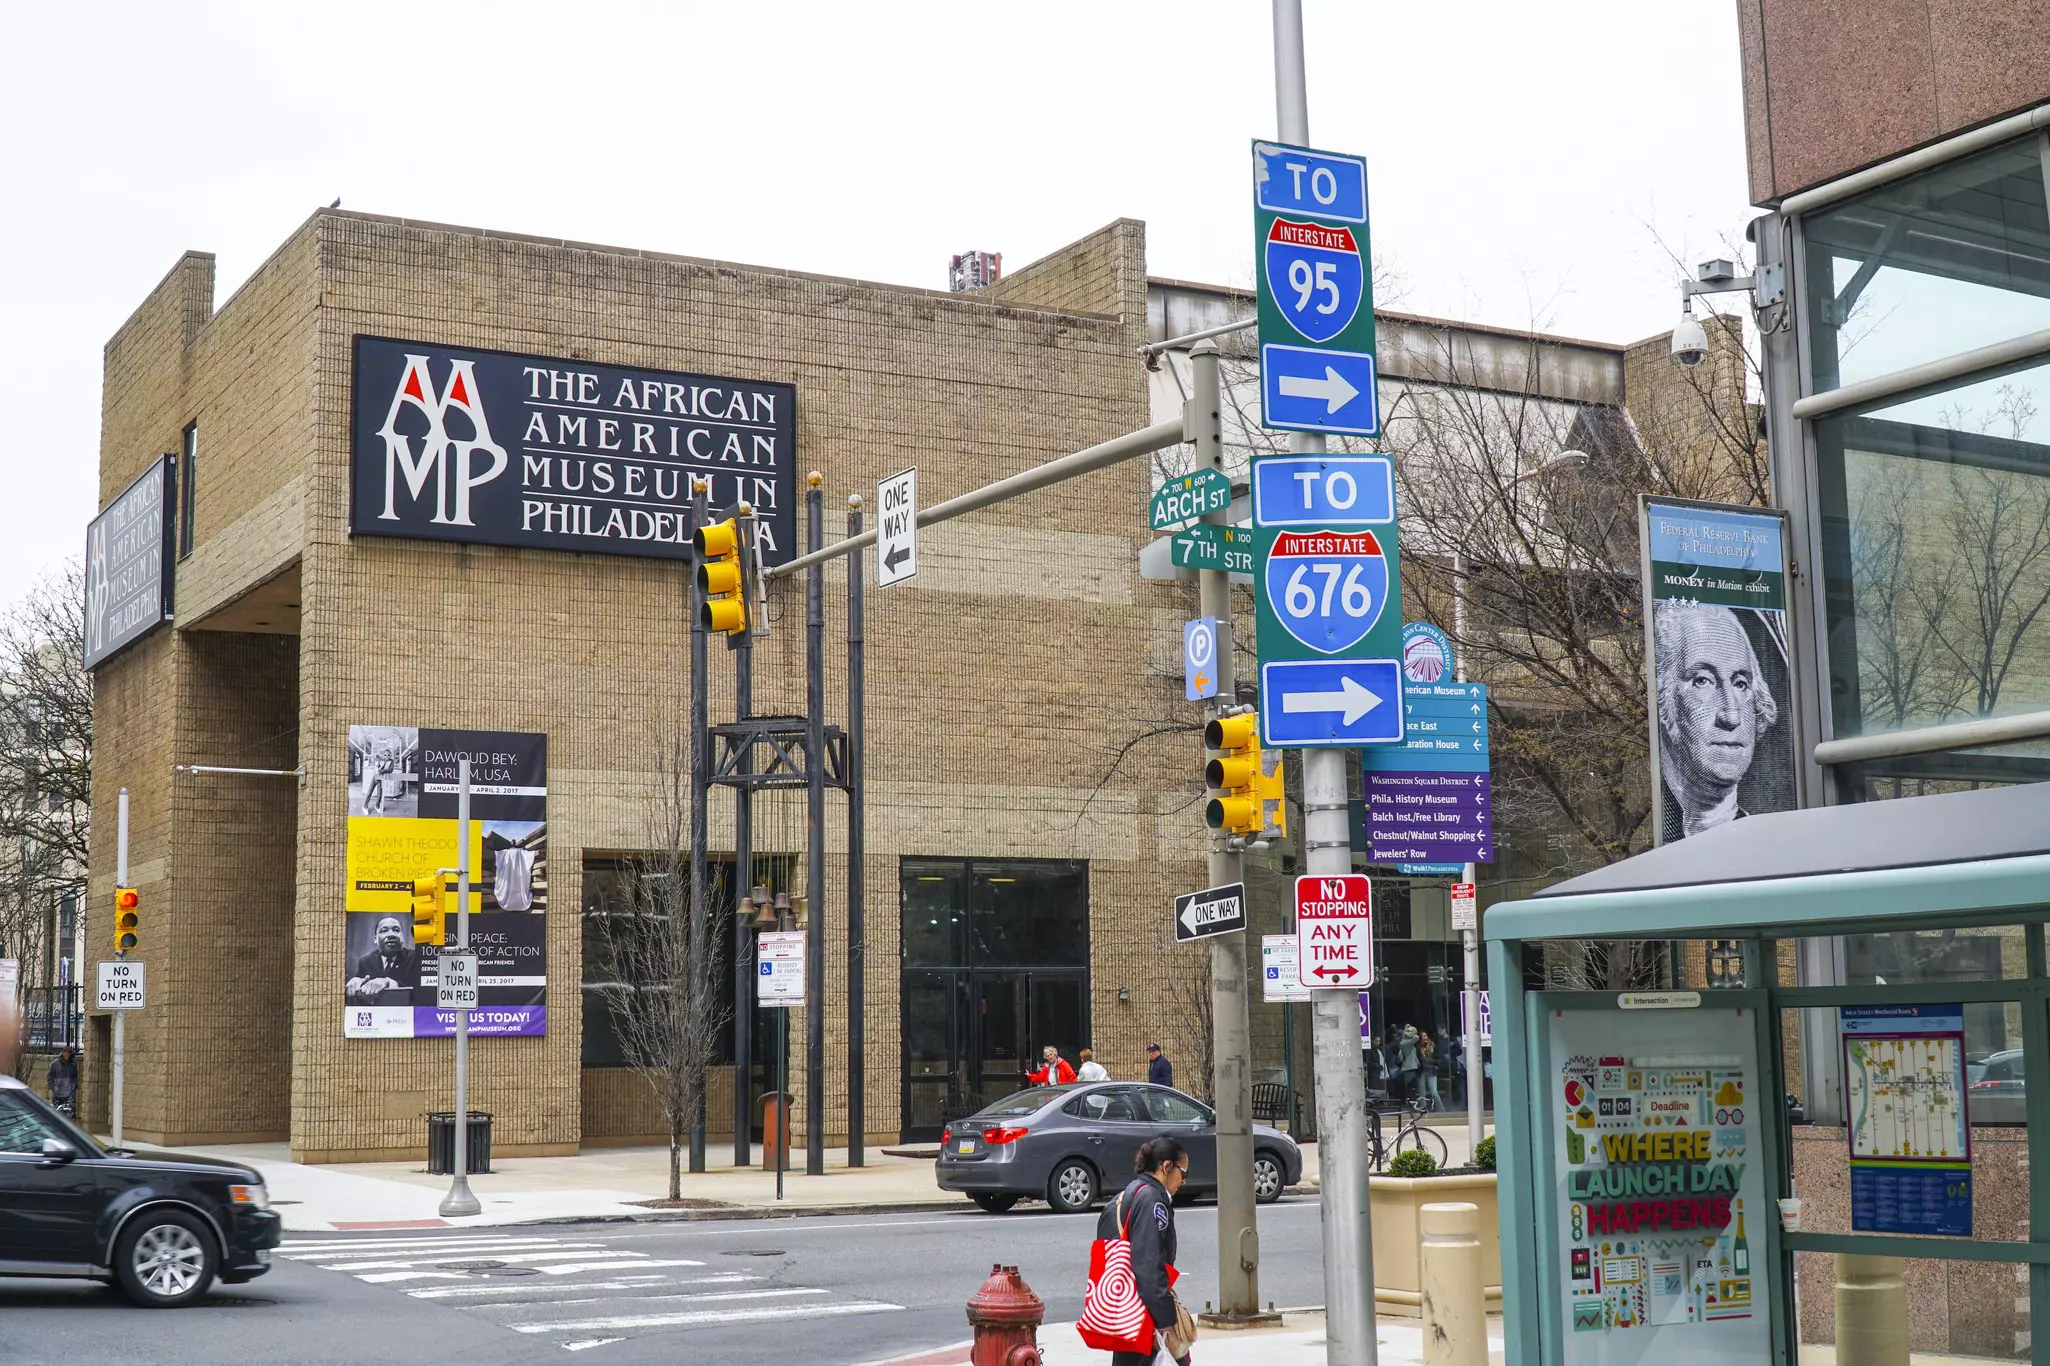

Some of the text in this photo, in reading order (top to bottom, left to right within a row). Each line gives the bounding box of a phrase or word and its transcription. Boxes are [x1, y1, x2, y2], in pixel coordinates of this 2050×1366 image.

[1286, 162, 1337, 205] TO
[1280, 225, 1345, 249] INTERSTATE
[1288, 259, 1340, 315] 95
[523, 367, 776, 424] THE AFRICAN
[522, 412, 776, 466] AMERICAN
[521, 455, 777, 509] MUSEUM IN
[1171, 475, 1206, 494] 700 W 600
[884, 481, 908, 511] ONE
[1293, 471, 1357, 510] TO
[113, 470, 160, 534] THE AFRICAN
[1154, 487, 1226, 526] ARCH ST
[521, 500, 778, 551] PHILADELA
[884, 509, 909, 540] WAY
[111, 507, 160, 570] AMERICAN
[1225, 529, 1233, 543] N
[1238, 533, 1251, 543] 100
[1660, 522, 1769, 545] FEDERAL RESERVE BANK
[1285, 538, 1367, 554] INTERSTATE
[1692, 540, 1755, 557] PHILADELPHIA
[1224, 551, 1254, 570] STR
[110, 546, 159, 606] MUSEUM IN
[1664, 575, 1770, 593] MONEY in Motion exhibit
[1284, 563, 1372, 618] 676
[109, 585, 158, 642] PHILADELPHIA
[1434, 686, 1466, 695] Museum
[1421, 722, 1437, 730] East
[1435, 740, 1459, 749] House
[425, 750, 517, 766] DAWOUD BEY:
[425, 767, 511, 781] HARLM, USA
[1371, 776, 1469, 786] WASHINGTON SQUARE DISTRICT
[1371, 794, 1458, 806] Phila. History Museum
[1372, 812, 1460, 824] Balch Inst./Free Library
[356, 836, 473, 850] SHAWN THEODO
[1373, 830, 1476, 842] Chestnut/Walnut Shopping
[356, 851, 430, 864] CHURCH OF
[1410, 849, 1427, 858] Row
[356, 866, 438, 879] BROKEN PIEC
[1320, 879, 1346, 900] NO
[1195, 899, 1237, 923] ONE WAY
[1301, 901, 1367, 916] STOPPING
[470, 933, 508, 943] PEACE:
[1311, 924, 1357, 940] ANY
[479, 947, 494, 957] OF
[497, 947, 540, 957] ACTION
[1310, 944, 1359, 960] TIME
[114, 967, 129, 976] NO
[451, 961, 465, 971] NO
[106, 979, 137, 989] TURN
[445, 975, 471, 986] TURN
[499, 976, 514, 984] 2017
[100, 992, 142, 1002] ON RED
[440, 990, 475, 1001] ON RED
[1633, 996, 1669, 1004] Intersection
[436, 1012, 530, 1023] VIS US TODAY!
[1651, 1100, 1689, 1112] Deadline
[1602, 1131, 1712, 1162] WHERE
[1568, 1163, 1747, 1199] LAUNCH DAY
[1587, 1196, 1732, 1235] HAPPENS
[1696, 1260, 1713, 1268] ETA
